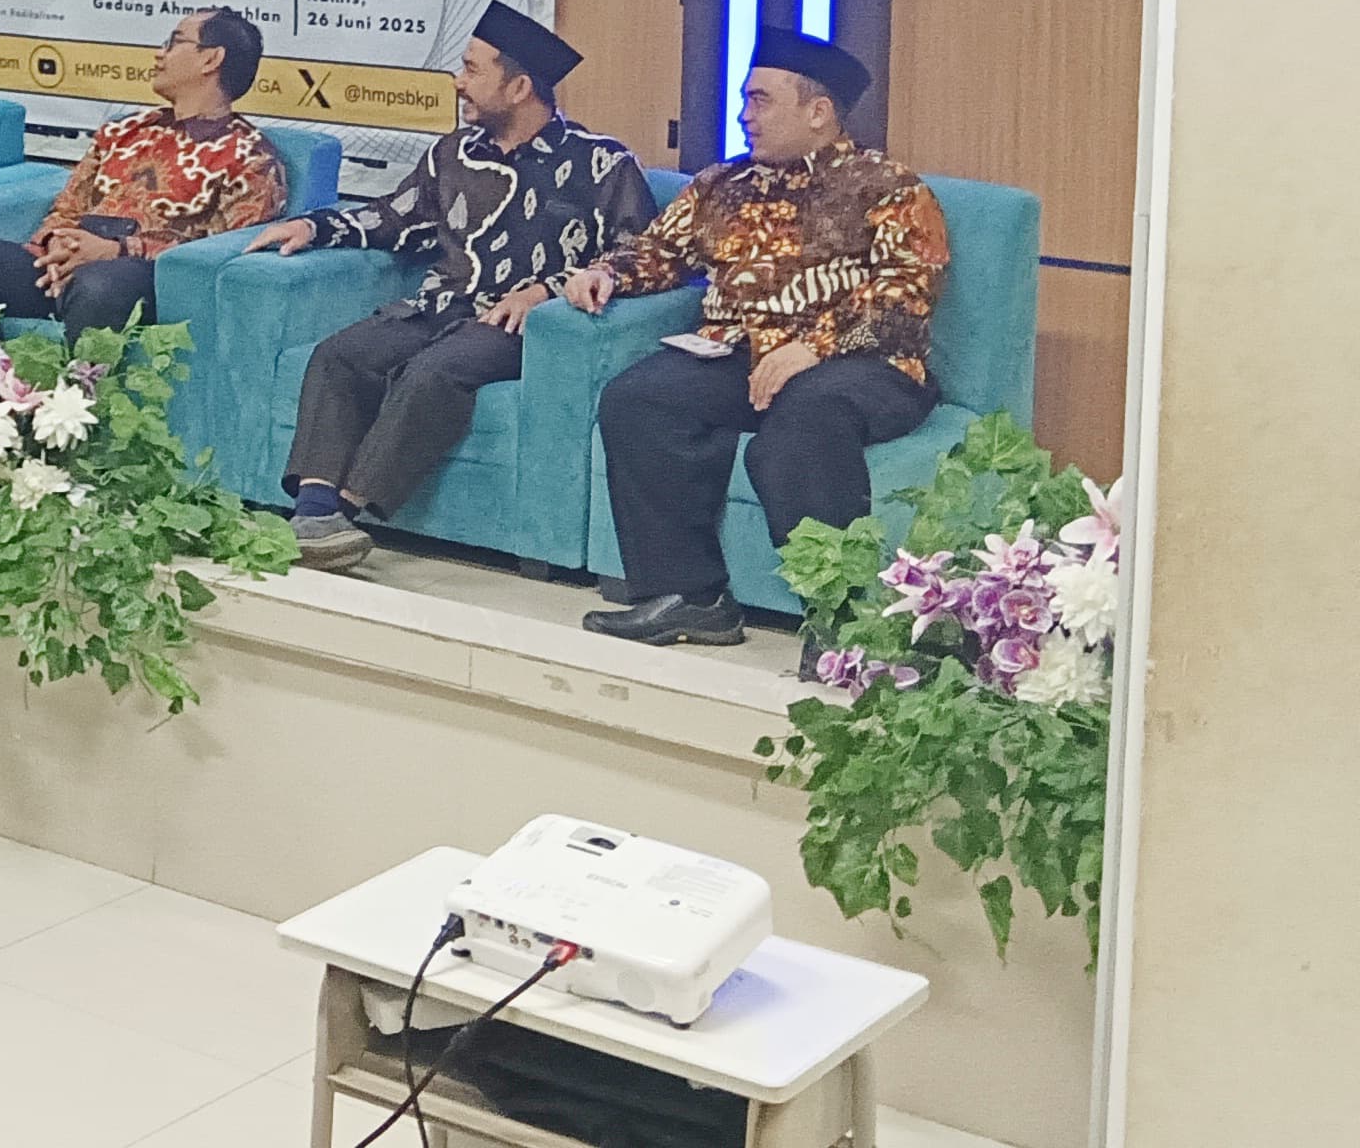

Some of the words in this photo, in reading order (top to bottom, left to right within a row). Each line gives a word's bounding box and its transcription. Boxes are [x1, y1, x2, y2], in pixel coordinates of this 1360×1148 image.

[307, 12, 329, 26] 26
[336, 15, 371, 31] Juni
[379, 17, 426, 34] 2025
[75, 63, 120, 81] HMPS
[126, 66, 158, 83] BKP
[344, 85, 440, 108] @hmpsbkpi
